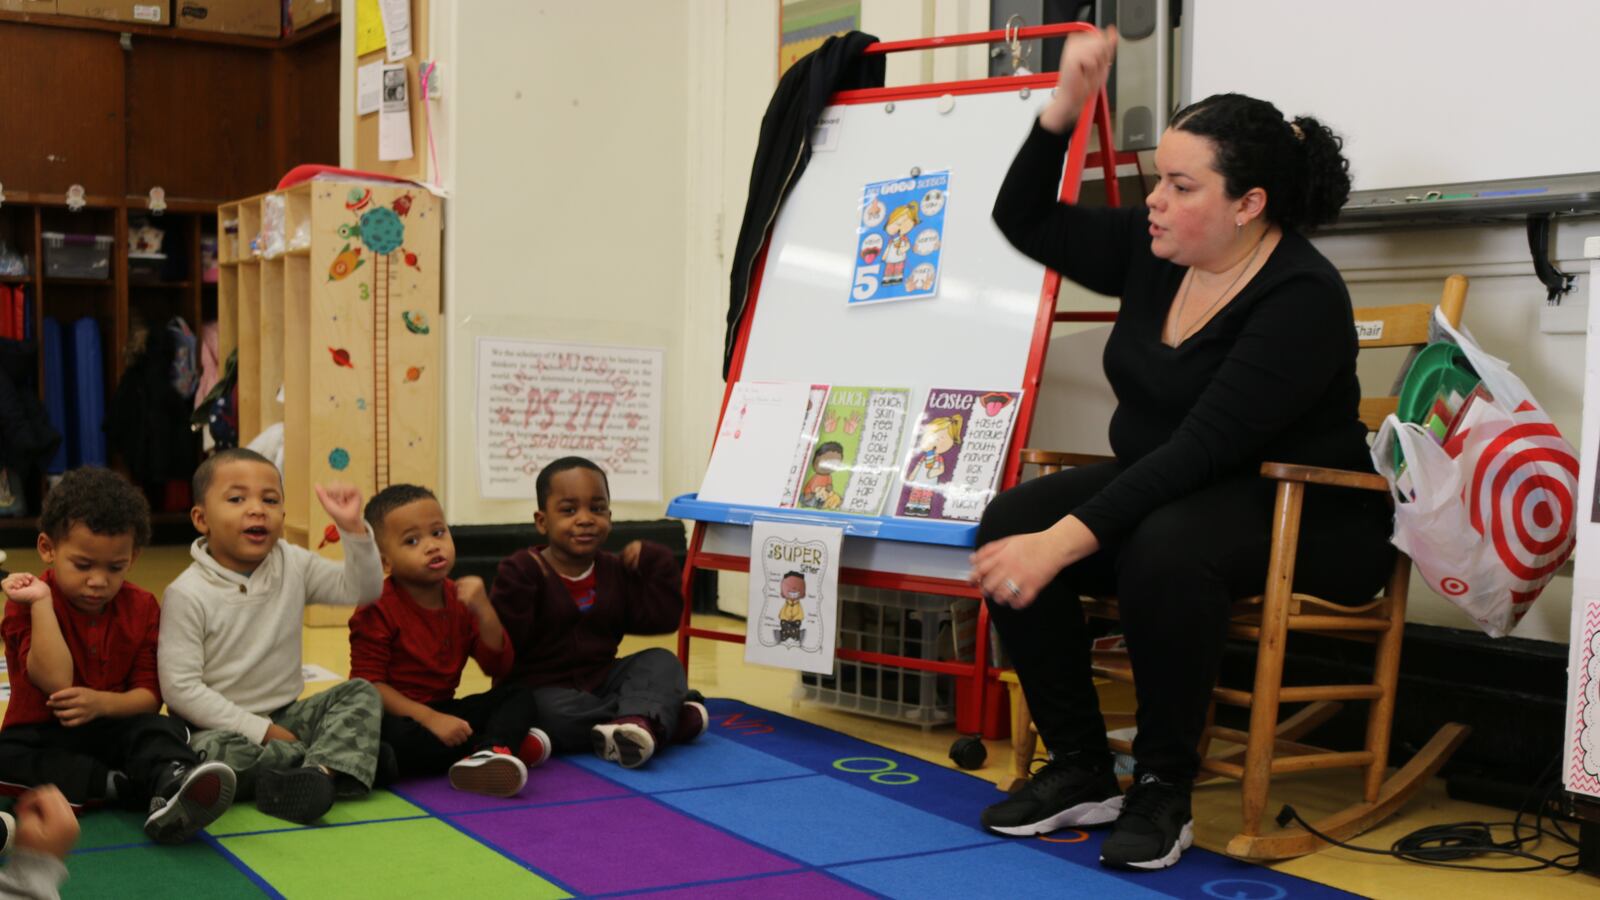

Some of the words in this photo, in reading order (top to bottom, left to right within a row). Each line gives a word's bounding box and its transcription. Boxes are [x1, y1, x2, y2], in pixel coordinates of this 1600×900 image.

[852, 264, 880, 301] 5
[873, 396, 902, 408] touch
[929, 392, 974, 410] taste
[523, 386, 560, 431] PS
[565, 391, 617, 433] 277
[874, 408, 895, 419] skin
[873, 420, 893, 431] feel
[975, 418, 1003, 428] taste
[871, 431, 888, 441] hot
[969, 430, 1003, 441] tongue
[531, 434, 606, 449] SCHOLARS
[967, 441, 997, 452] mouth
[867, 442, 888, 453] cold
[863, 454, 885, 465] soft
[857, 475, 879, 487] hold
[856, 487, 875, 497] tap
[850, 497, 868, 508] pet
[774, 544, 822, 566] SUPER
